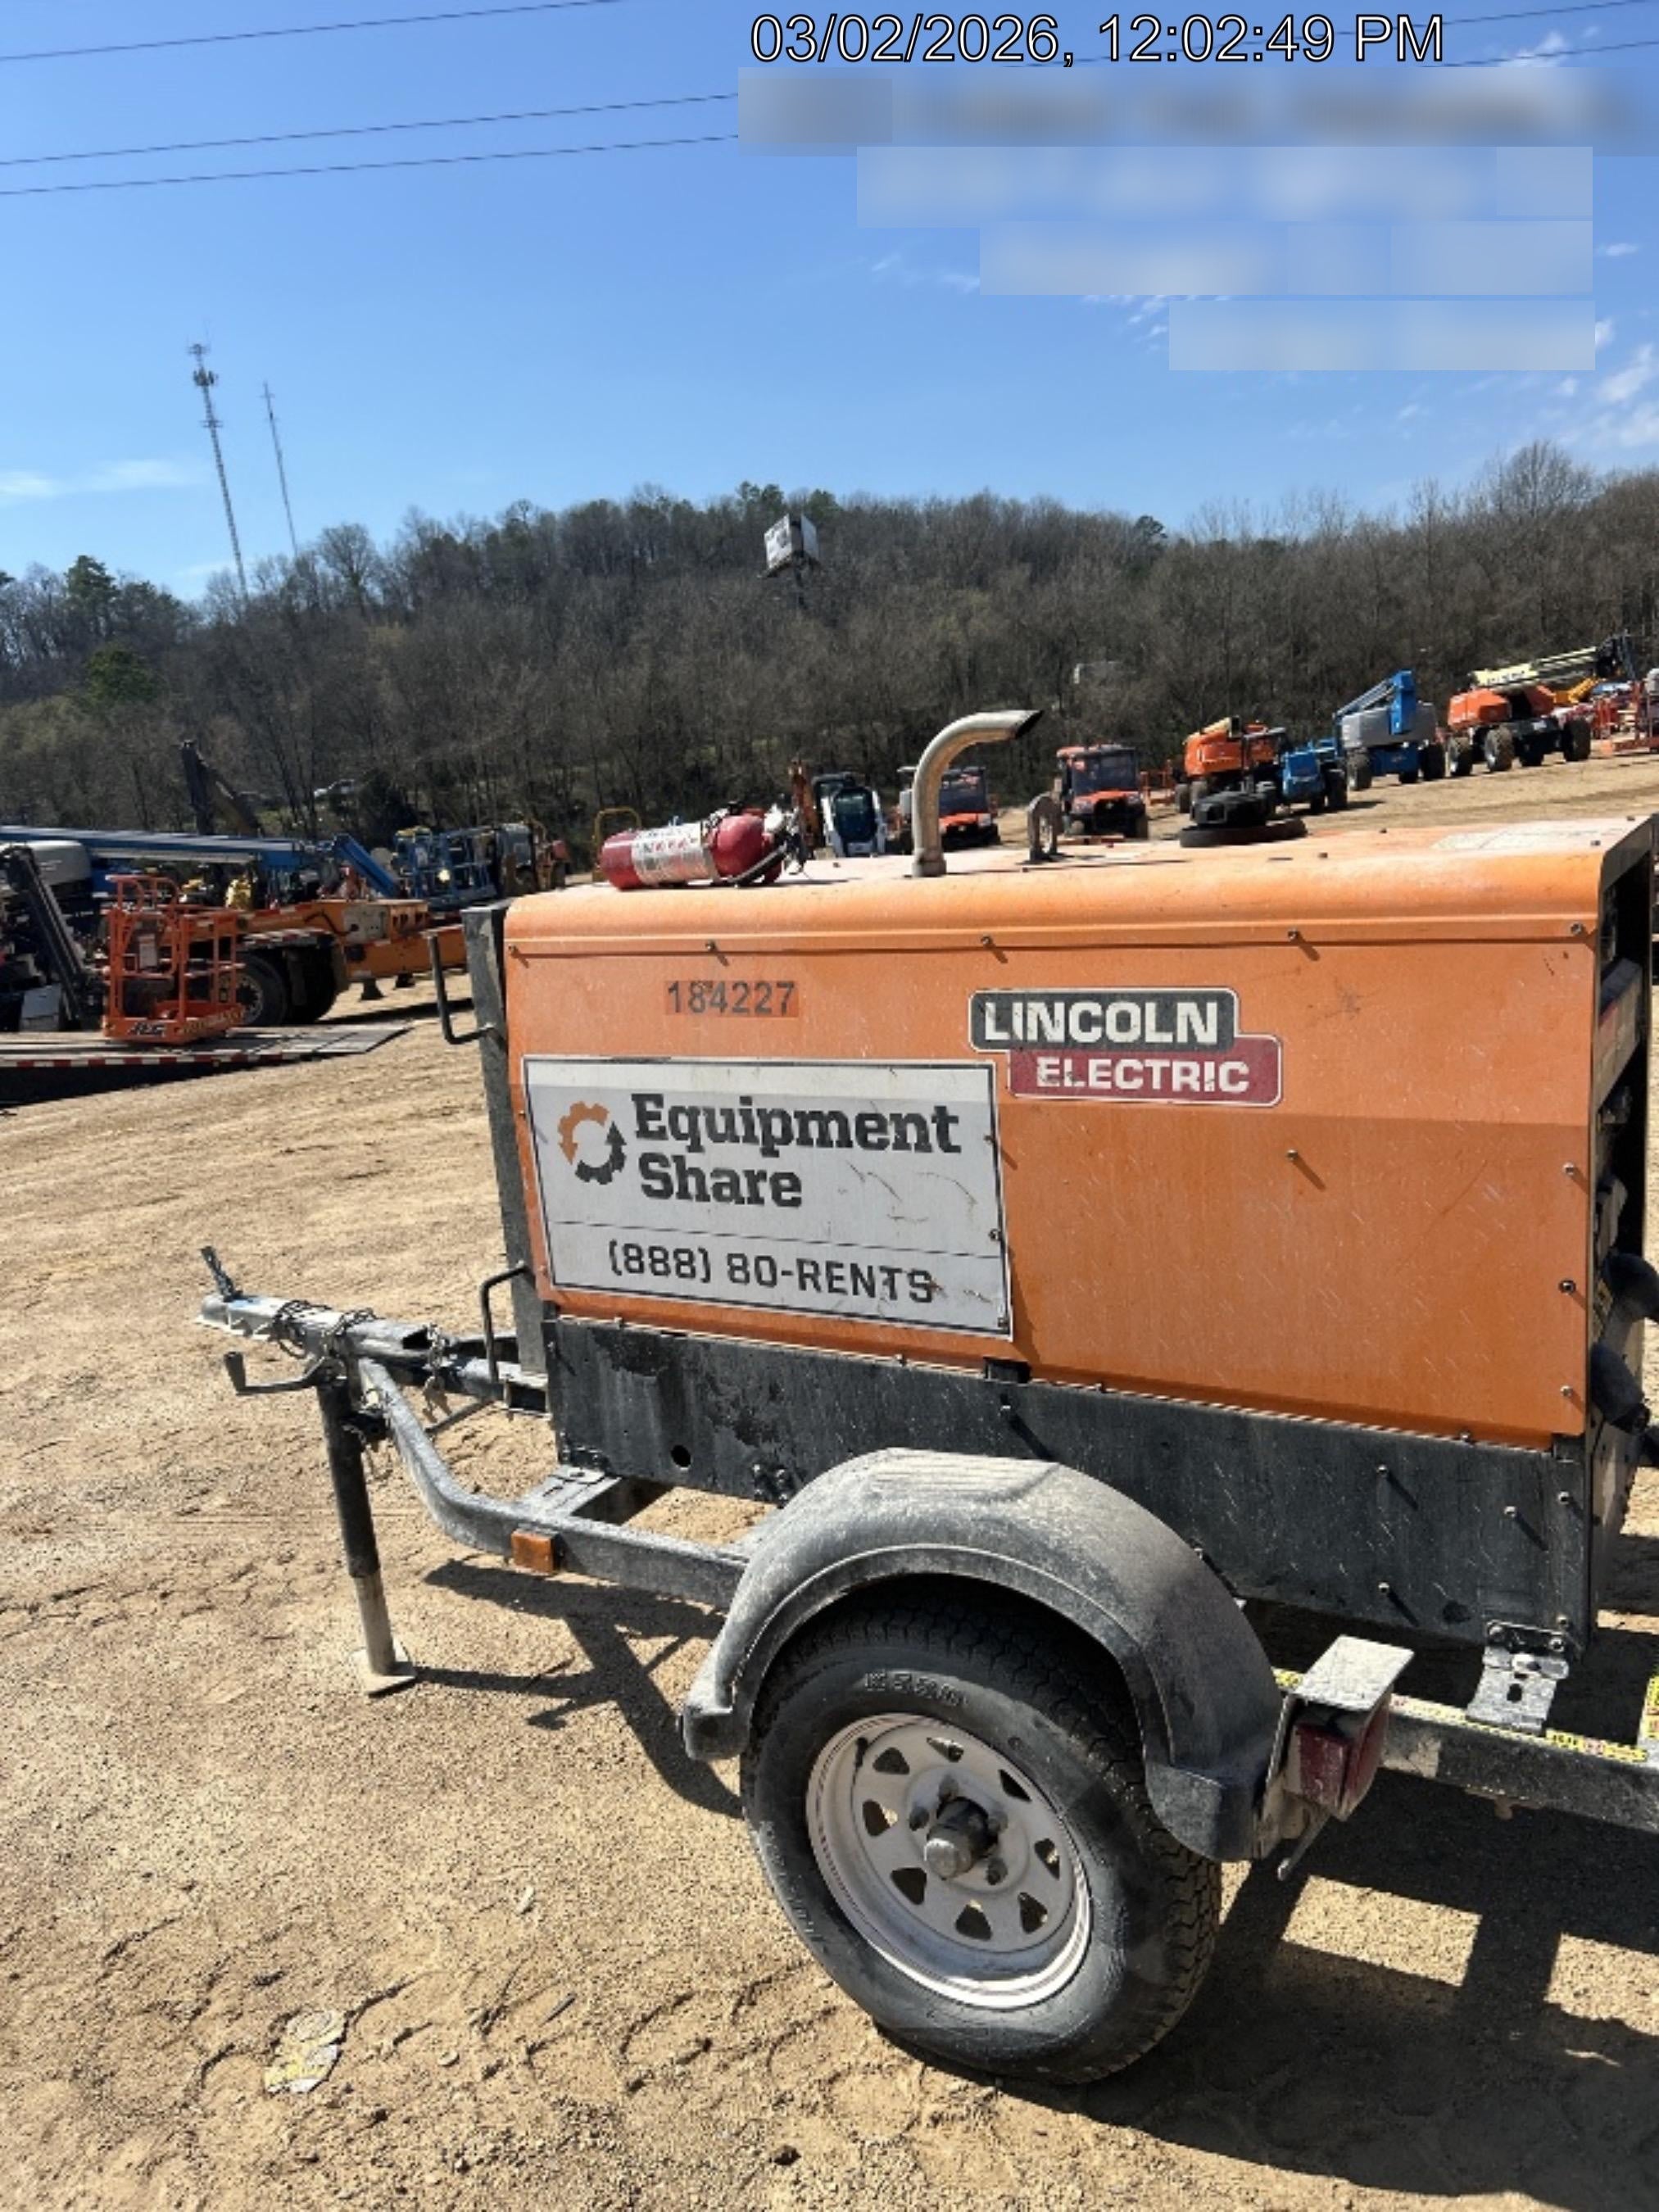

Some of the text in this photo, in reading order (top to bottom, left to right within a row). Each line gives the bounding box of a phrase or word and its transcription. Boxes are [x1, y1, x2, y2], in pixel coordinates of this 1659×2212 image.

[667, 981, 796, 1016] 184227
[984, 999, 1218, 1045] LINCOLN
[1036, 1057, 1249, 1094] ELECTRIC
[631, 1093, 962, 1156] Equipment
[637, 1153, 803, 1207] Share
[609, 1239, 934, 1303] (888) 80-RENTS
